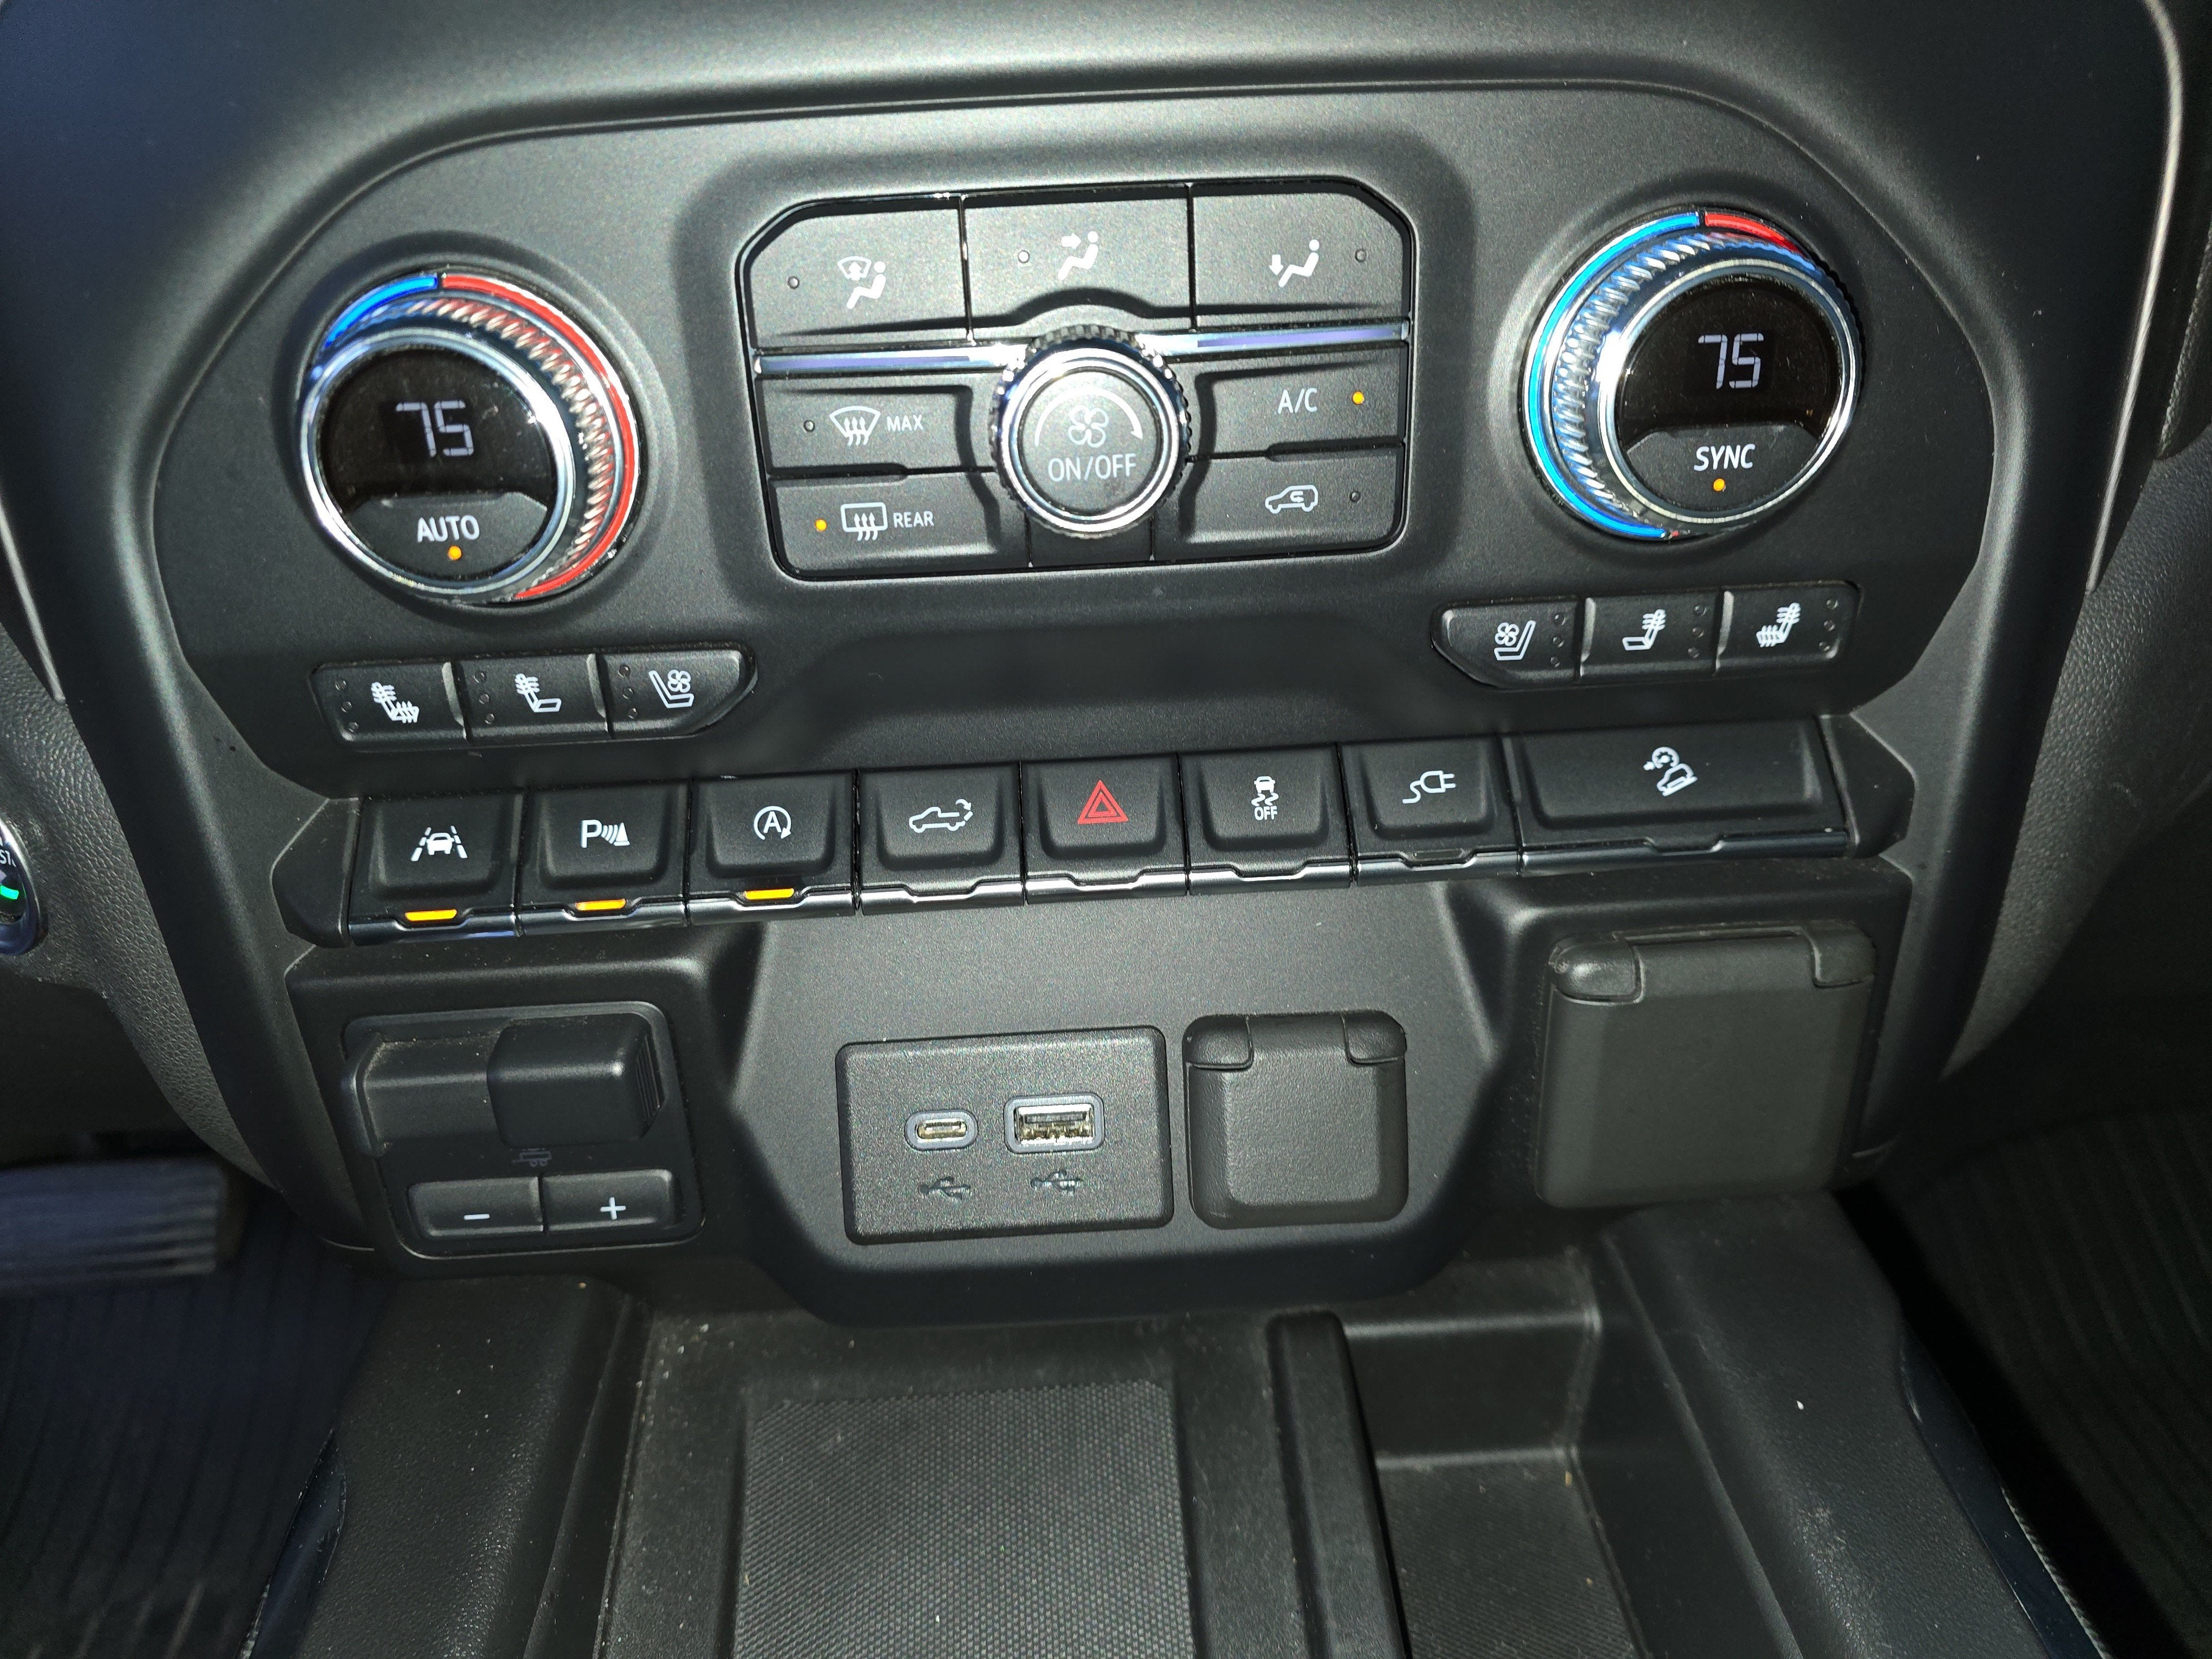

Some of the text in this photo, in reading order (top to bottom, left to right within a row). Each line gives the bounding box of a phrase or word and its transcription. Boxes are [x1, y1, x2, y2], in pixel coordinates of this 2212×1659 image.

[1697, 333, 1764, 389] 75
[1277, 387, 1317, 414] A/C
[396, 400, 474, 457] 75
[886, 414, 924, 432] MAX
[1047, 453, 1137, 482] ON/OFF
[1693, 443, 1756, 471] SYNC
[417, 515, 480, 542] AUTO
[893, 511, 935, 529] REAR
[1254, 806, 1278, 820] OFF
[581, 819, 601, 848] P
